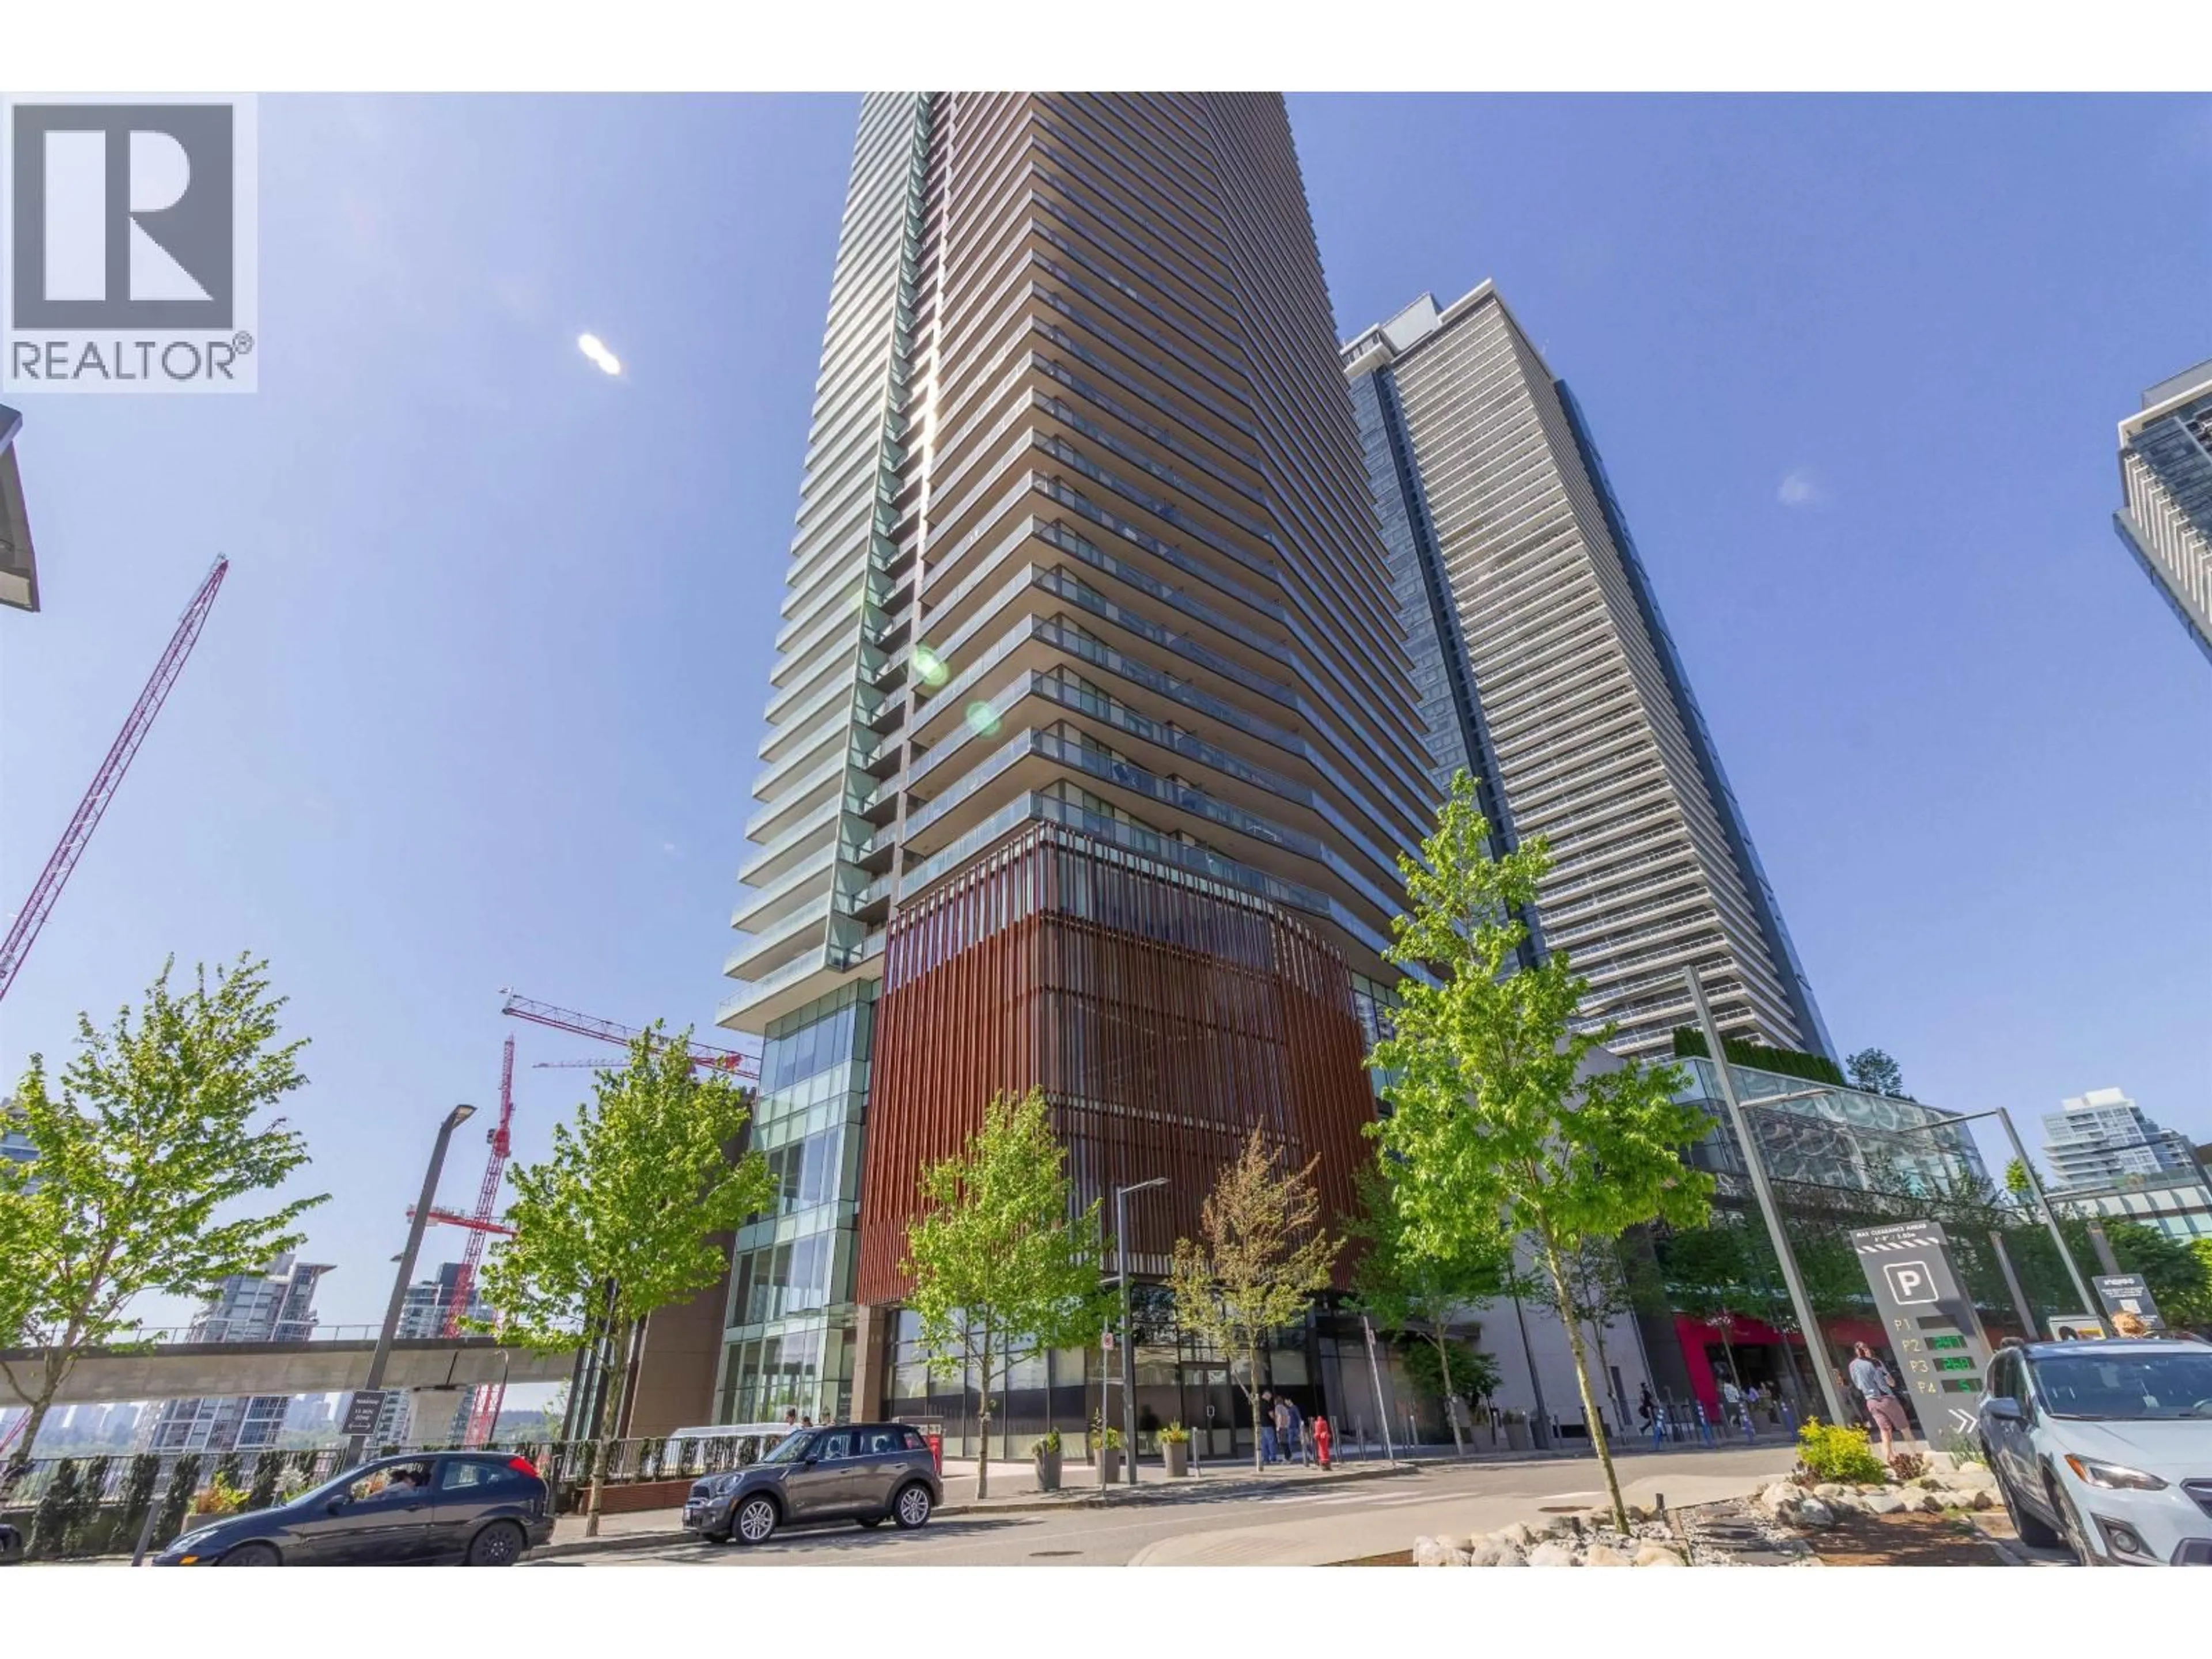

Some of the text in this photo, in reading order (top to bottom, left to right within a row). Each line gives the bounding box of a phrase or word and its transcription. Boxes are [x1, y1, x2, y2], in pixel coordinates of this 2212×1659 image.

[1897, 1270, 1921, 1296] P
[1893, 1318, 1912, 1331] P1
[1902, 1339, 1921, 1352] P2
[1910, 1359, 1929, 1373] P3
[1917, 1381, 1936, 1393] P4
